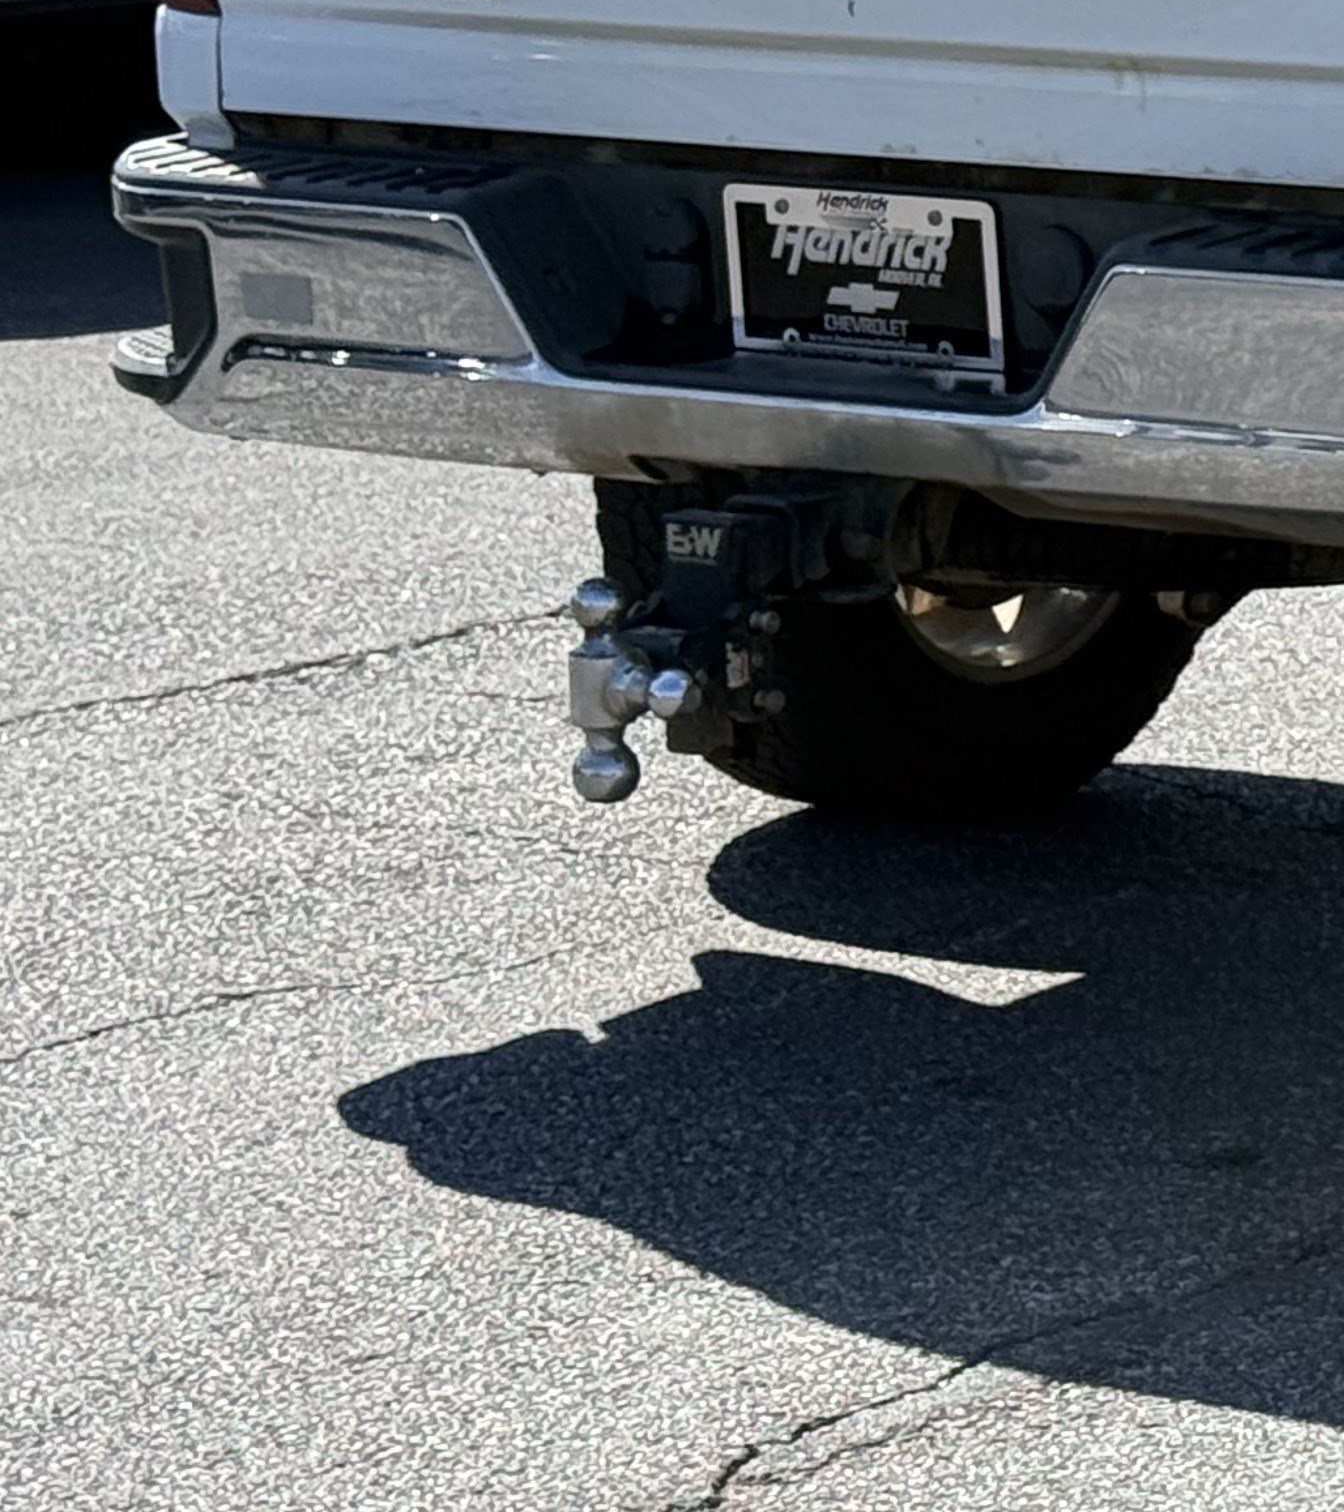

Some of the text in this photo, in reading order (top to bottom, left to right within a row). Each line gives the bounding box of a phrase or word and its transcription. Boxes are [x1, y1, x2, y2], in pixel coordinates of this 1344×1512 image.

[816, 191, 890, 213] Hendrick
[770, 224, 954, 276] Hendrick
[823, 313, 910, 338] CHEVROLET
